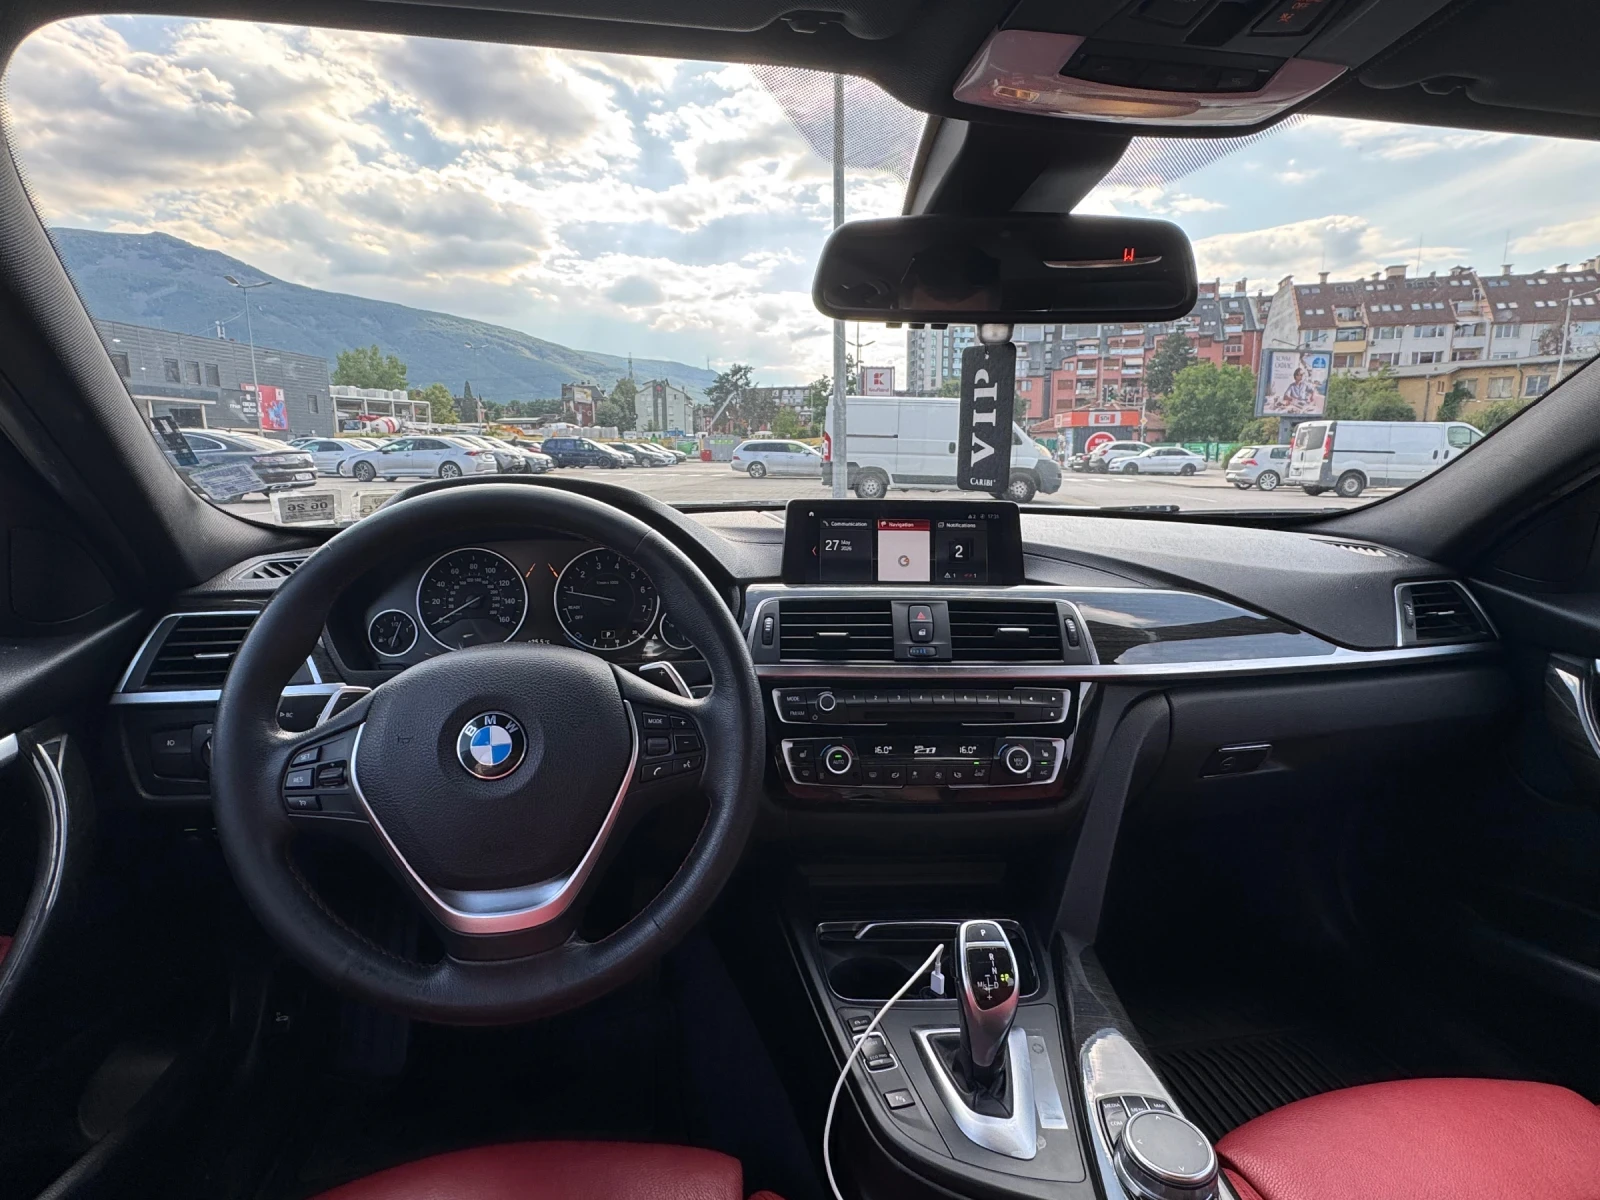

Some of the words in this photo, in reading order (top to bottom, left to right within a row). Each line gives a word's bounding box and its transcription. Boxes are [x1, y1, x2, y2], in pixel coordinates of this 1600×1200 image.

[1123, 247, 1135, 261] W
[971, 369, 998, 467] VIP
[825, 540, 839, 550] 27
[955, 545, 963, 558] 2
[596, 562, 602, 570] 3
[614, 562, 620, 570] 4
[464, 714, 519, 737] BMW
[994, 981, 999, 989] D
